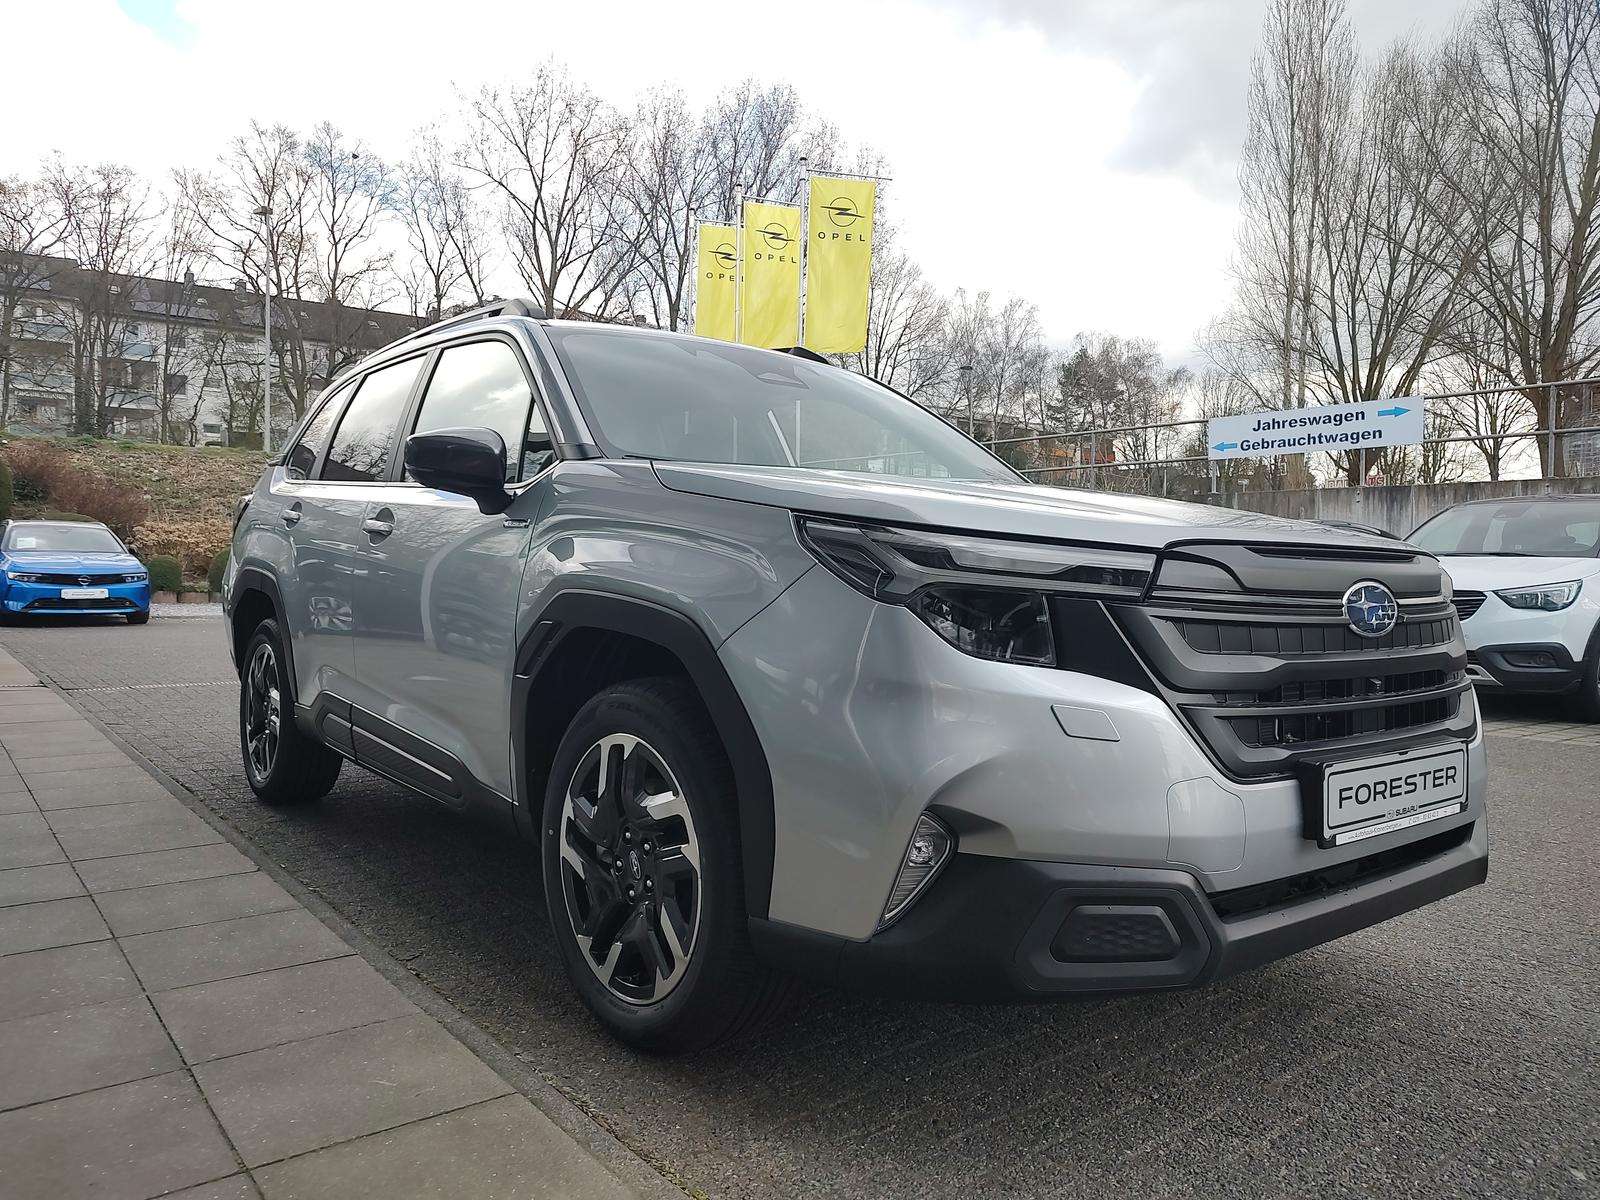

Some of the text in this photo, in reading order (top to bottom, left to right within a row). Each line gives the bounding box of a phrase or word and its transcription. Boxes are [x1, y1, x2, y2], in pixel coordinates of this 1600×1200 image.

[817, 231, 866, 242] OPEL
[754, 252, 797, 264] OPEL
[1252, 410, 1365, 432] Jahreswagen
[1240, 428, 1382, 451] Gebrauchtwagen
[1338, 765, 1457, 809] FORESTER
[1395, 804, 1418, 817] SUBARU
